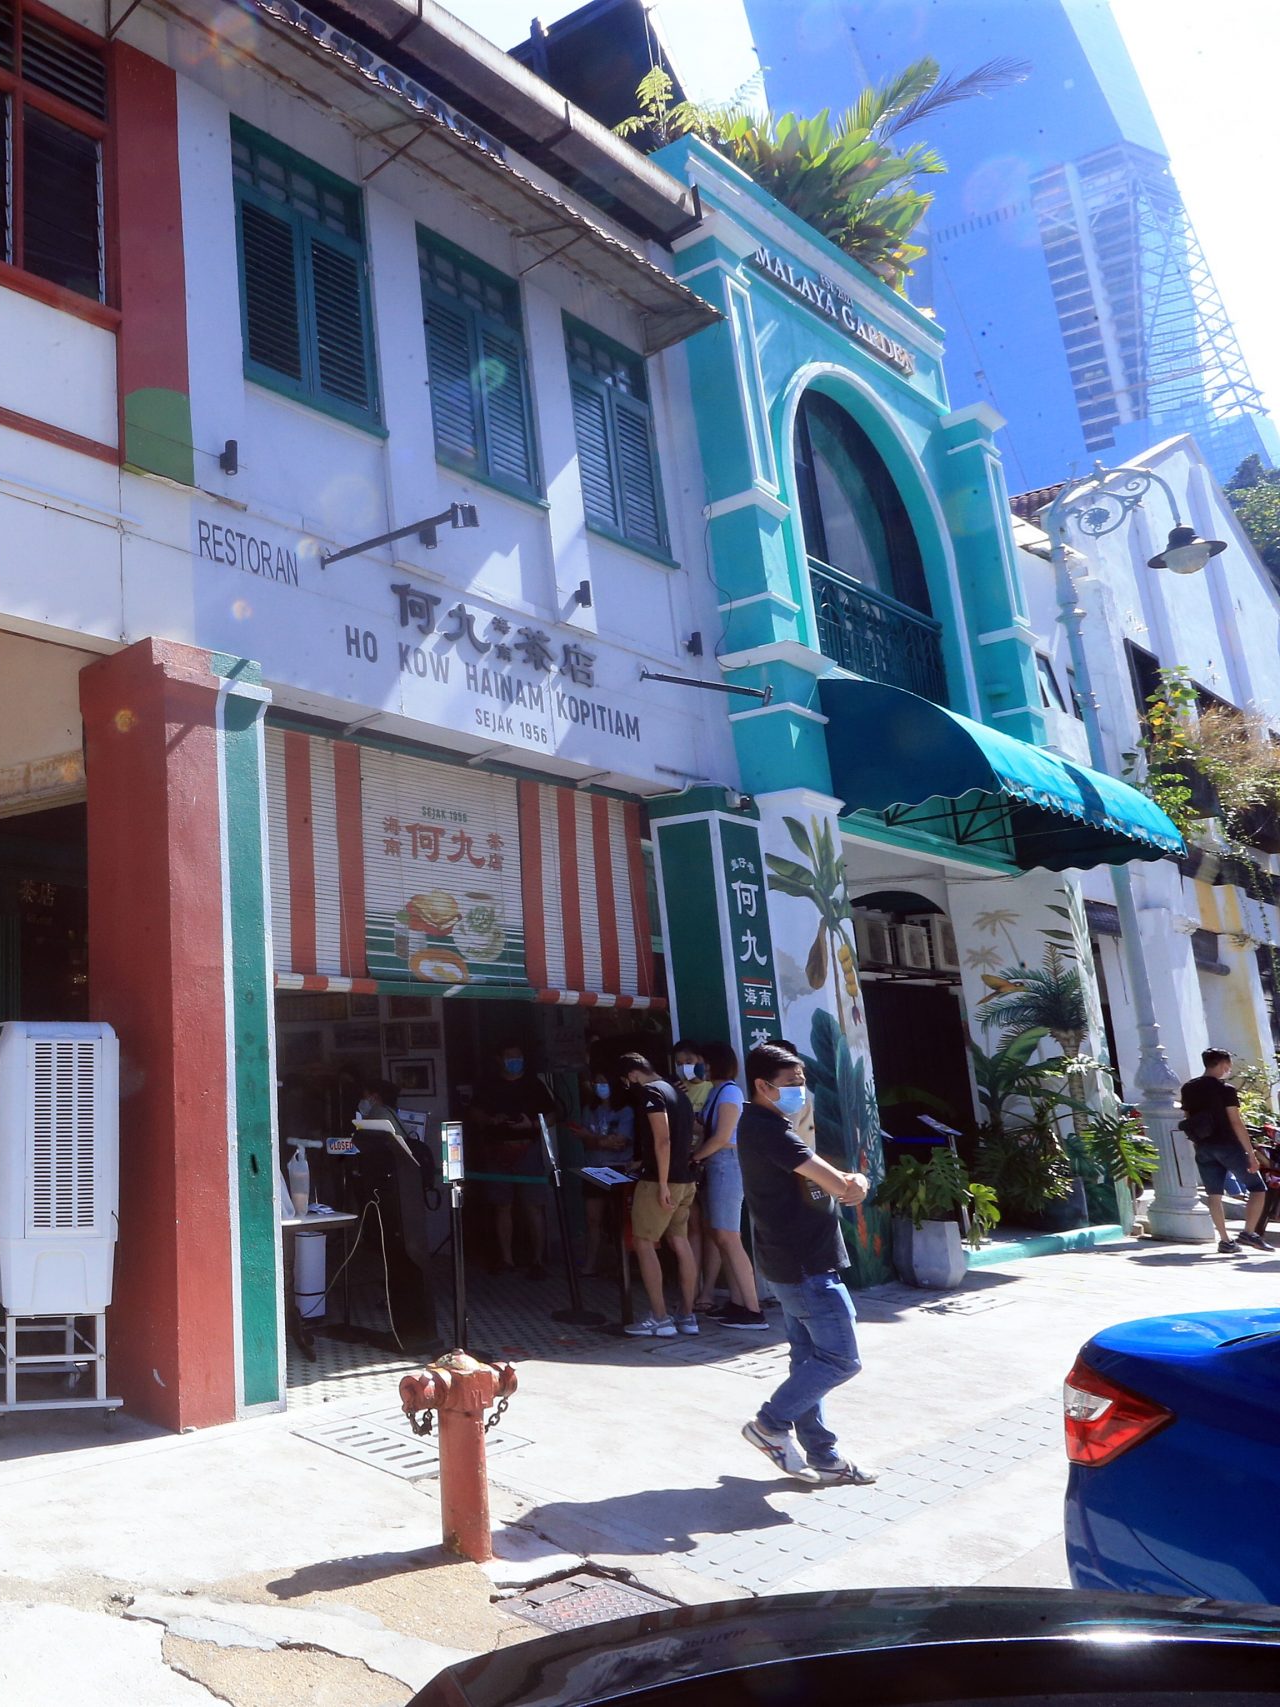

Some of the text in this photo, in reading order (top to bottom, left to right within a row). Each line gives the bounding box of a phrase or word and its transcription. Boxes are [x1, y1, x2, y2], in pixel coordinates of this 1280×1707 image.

[754, 246, 916, 373] MALAYA GARDEN
[198, 519, 299, 587] RESTORAN
[345, 624, 641, 742] HO KOW HAINAM KOPITIAM
[475, 708, 548, 745] SEJAK 1956
[422, 806, 468, 823] SEJAK 1956
[329, 1140, 354, 1151] CLOSED
